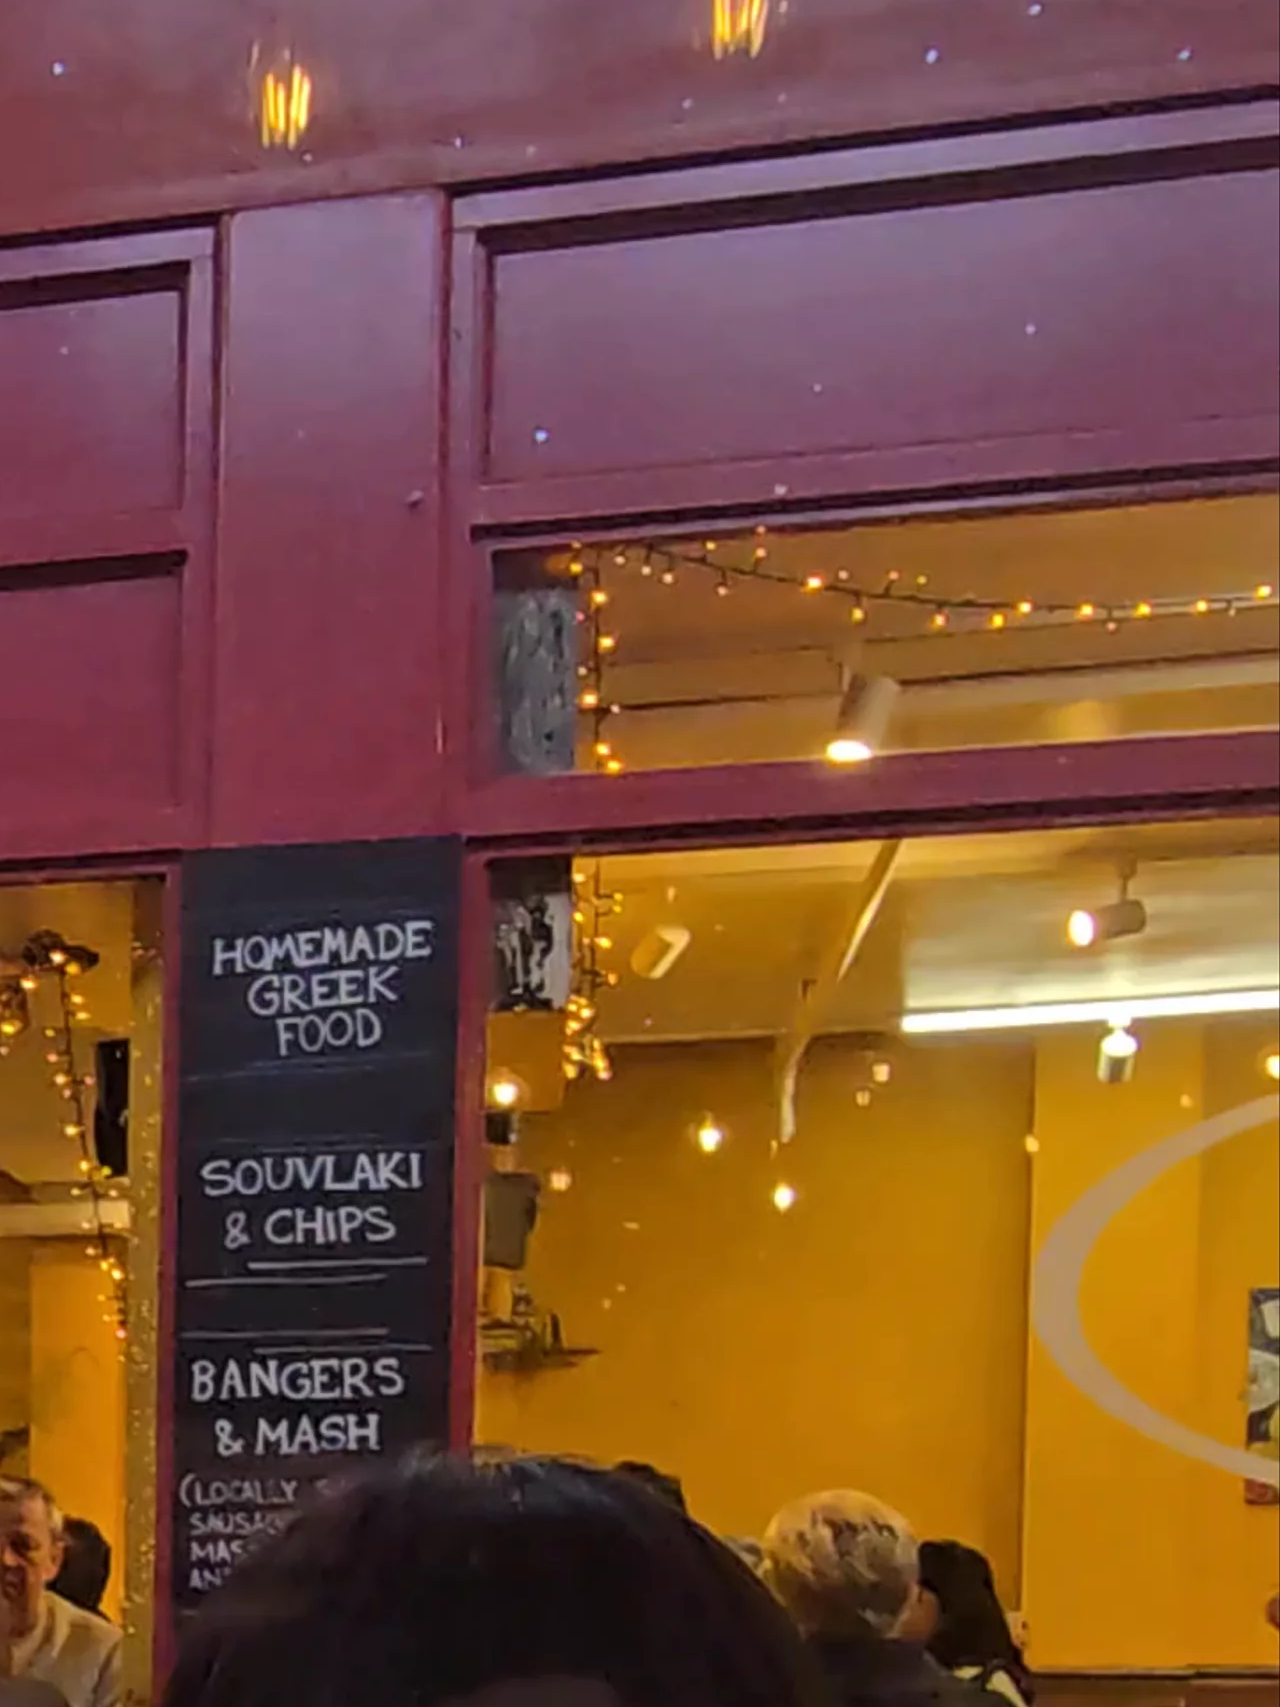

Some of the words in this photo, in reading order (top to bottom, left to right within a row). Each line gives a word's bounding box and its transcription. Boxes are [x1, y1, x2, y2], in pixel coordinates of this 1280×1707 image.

[212, 920, 434, 976] HOMEMADE
[247, 965, 400, 1016] GREEK
[276, 1007, 382, 1056] FOOD
[200, 1151, 423, 1197] SOUVLAKI
[224, 1210, 251, 1250] &
[264, 1205, 397, 1244] CHIPS
[190, 1357, 405, 1403] BANGERS
[214, 1417, 245, 1457] &
[254, 1413, 381, 1455] MASH
[189, 1566, 232, 1590] AN
